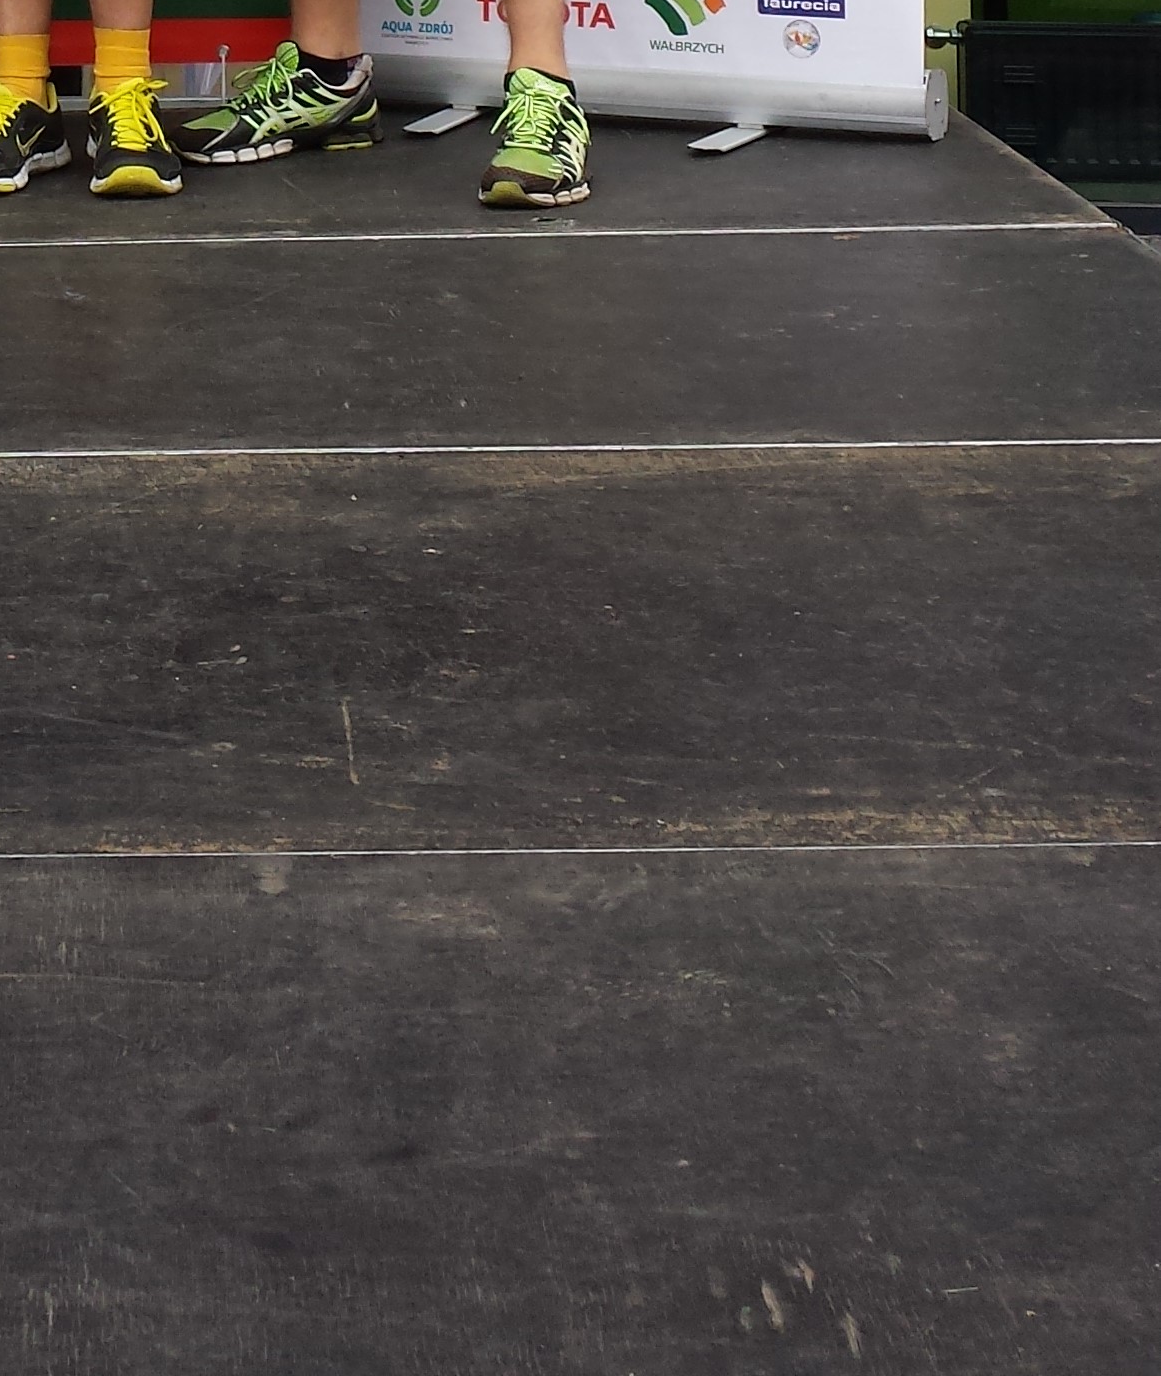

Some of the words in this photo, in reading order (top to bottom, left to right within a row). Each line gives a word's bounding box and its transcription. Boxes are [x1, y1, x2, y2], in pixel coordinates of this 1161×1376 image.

[381, 20, 413, 33] AQUA
[418, 20, 454, 35] ZDRÓJ
[649, 39, 725, 54] WAŁBRZYCH
